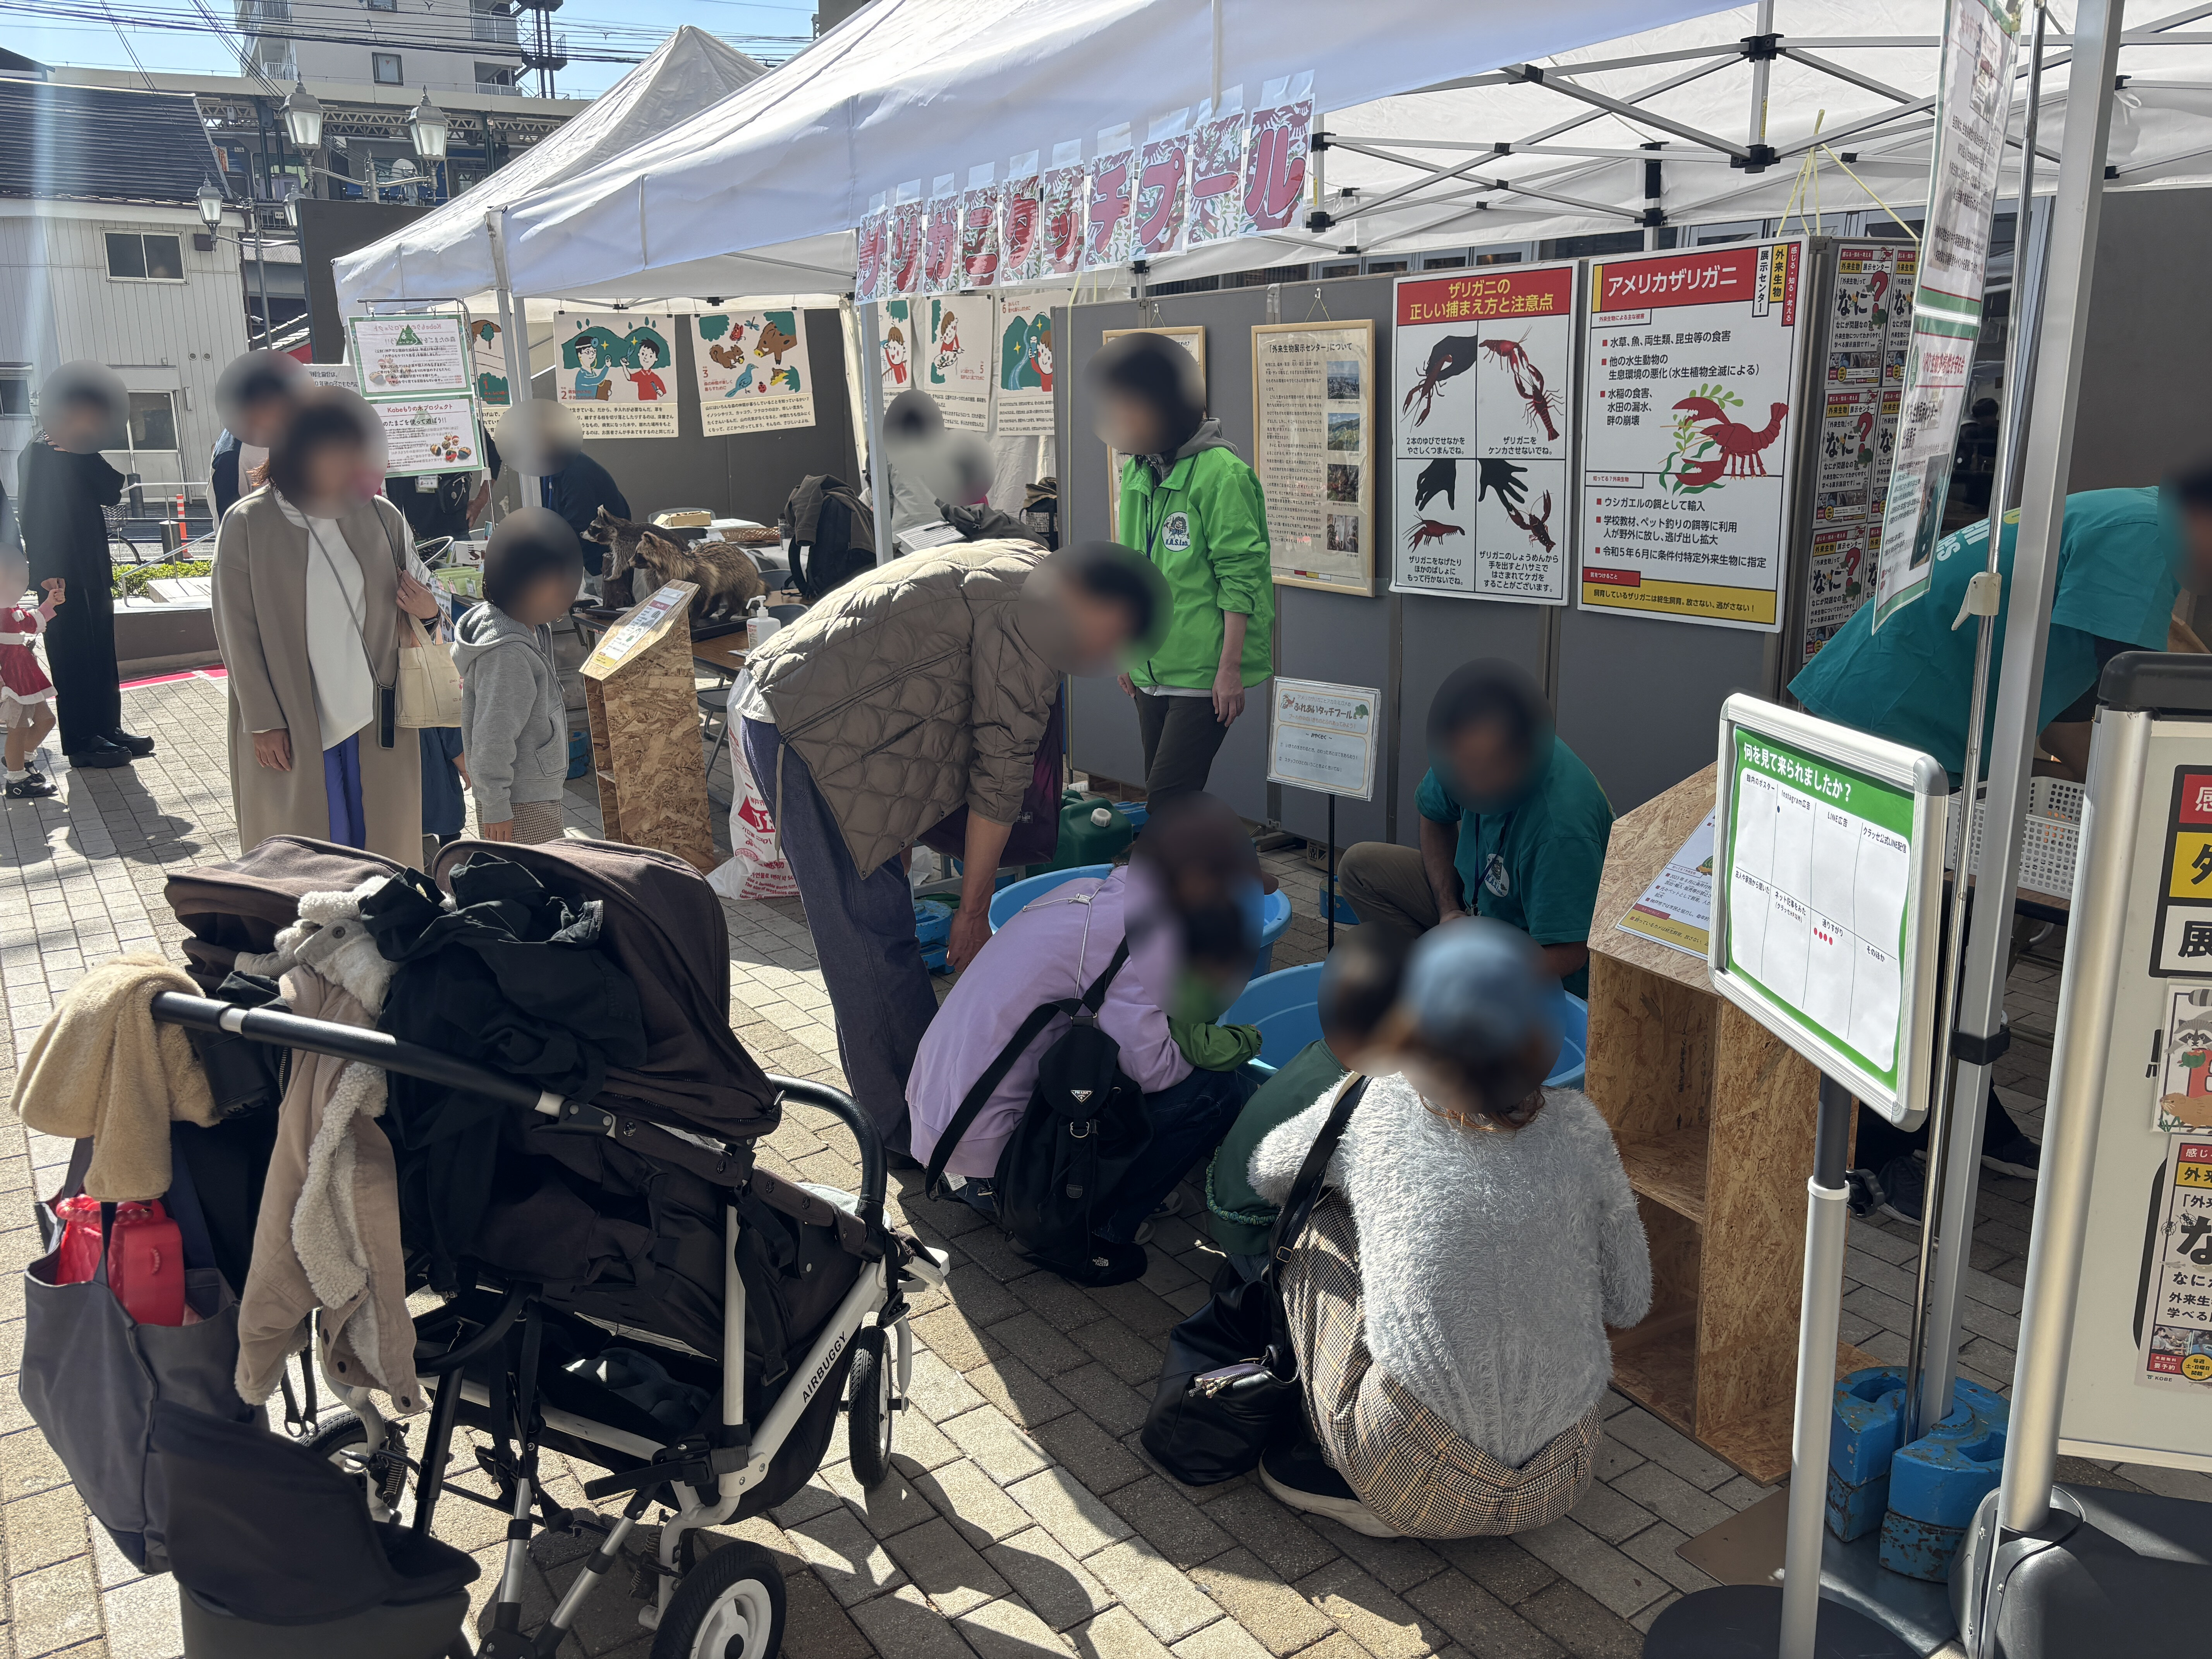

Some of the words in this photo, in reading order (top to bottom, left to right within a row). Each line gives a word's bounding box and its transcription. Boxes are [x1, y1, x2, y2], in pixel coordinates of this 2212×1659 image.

[862, 125, 1306, 296] ザリガニタッチプール
[1608, 265, 1737, 297] アメリカザリガニ
[1773, 249, 1784, 297] 外来生物
[1449, 279, 1510, 298] ザリガニの
[1757, 251, 1769, 313] 展示センター
[1786, 246, 1797, 322] 感じる・知る・考える
[1002, 304, 1006, 314] 6
[1410, 293, 1554, 320] 正しい捕まえ方と注意点
[1610, 330, 1731, 348] 水草、魚、両生類、昆虫等の食害
[1269, 343, 1352, 353] 「外来生物展示センター」について
[1609, 354, 1668, 367] 他の水生動物の
[702, 369, 708, 378] 3
[561, 391, 567, 399] 2
[1608, 388, 1653, 399] 水稲の食害、
[387, 404, 452, 413] Kobeもりの木プロジェクト
[1607, 402, 1652, 412] 水田の漏水、
[1407, 436, 1465, 445] 2本のゆびでせなかを
[1503, 436, 1536, 445] ザリガニを
[1407, 446, 1465, 455] やさしくつまんでね。
[1489, 446, 1553, 455] ケンカさせないでね。
[1604, 498, 1705, 512] ウシガエルの餌として輸入
[1604, 515, 1737, 533] 学校教材、ペット釣りの餌等に利用
[1603, 529, 1718, 546] 人が野外に放し、逃げ出し拡大
[1409, 556, 1462, 566] ザリガニをなげたり
[1479, 551, 1559, 563] ザリガニのしょうめんから
[1603, 546, 1767, 568] 令和5年6月に条件付特定外来生物に指定
[1488, 561, 1548, 572] 手を出すとハサミで
[1407, 574, 1463, 585] もって行かないでね。
[1492, 571, 1544, 582] はさまれてケガを
[1484, 580, 1553, 592] することがございます。
[1294, 702, 1352, 719] ふれあいタッチプール
[1744, 742, 1851, 802] 何を見て来られましたか？
[1747, 774, 1775, 791] 館内のポスター
[1781, 789, 1810, 811] Instagram広告
[1827, 811, 1848, 828] LINE広告
[1863, 826, 1907, 854] クラッセ公式LINE配信
[1735, 870, 1770, 895] 友人や家族から聞いた
[1775, 891, 1807, 916] ネット記事をみた
[1822, 919, 1844, 937] 通りすがり
[1867, 945, 1885, 962] そのほか
[802, 1331, 847, 1404] AIRBUGGY
[2154, 1363, 2176, 1371] 要予約
